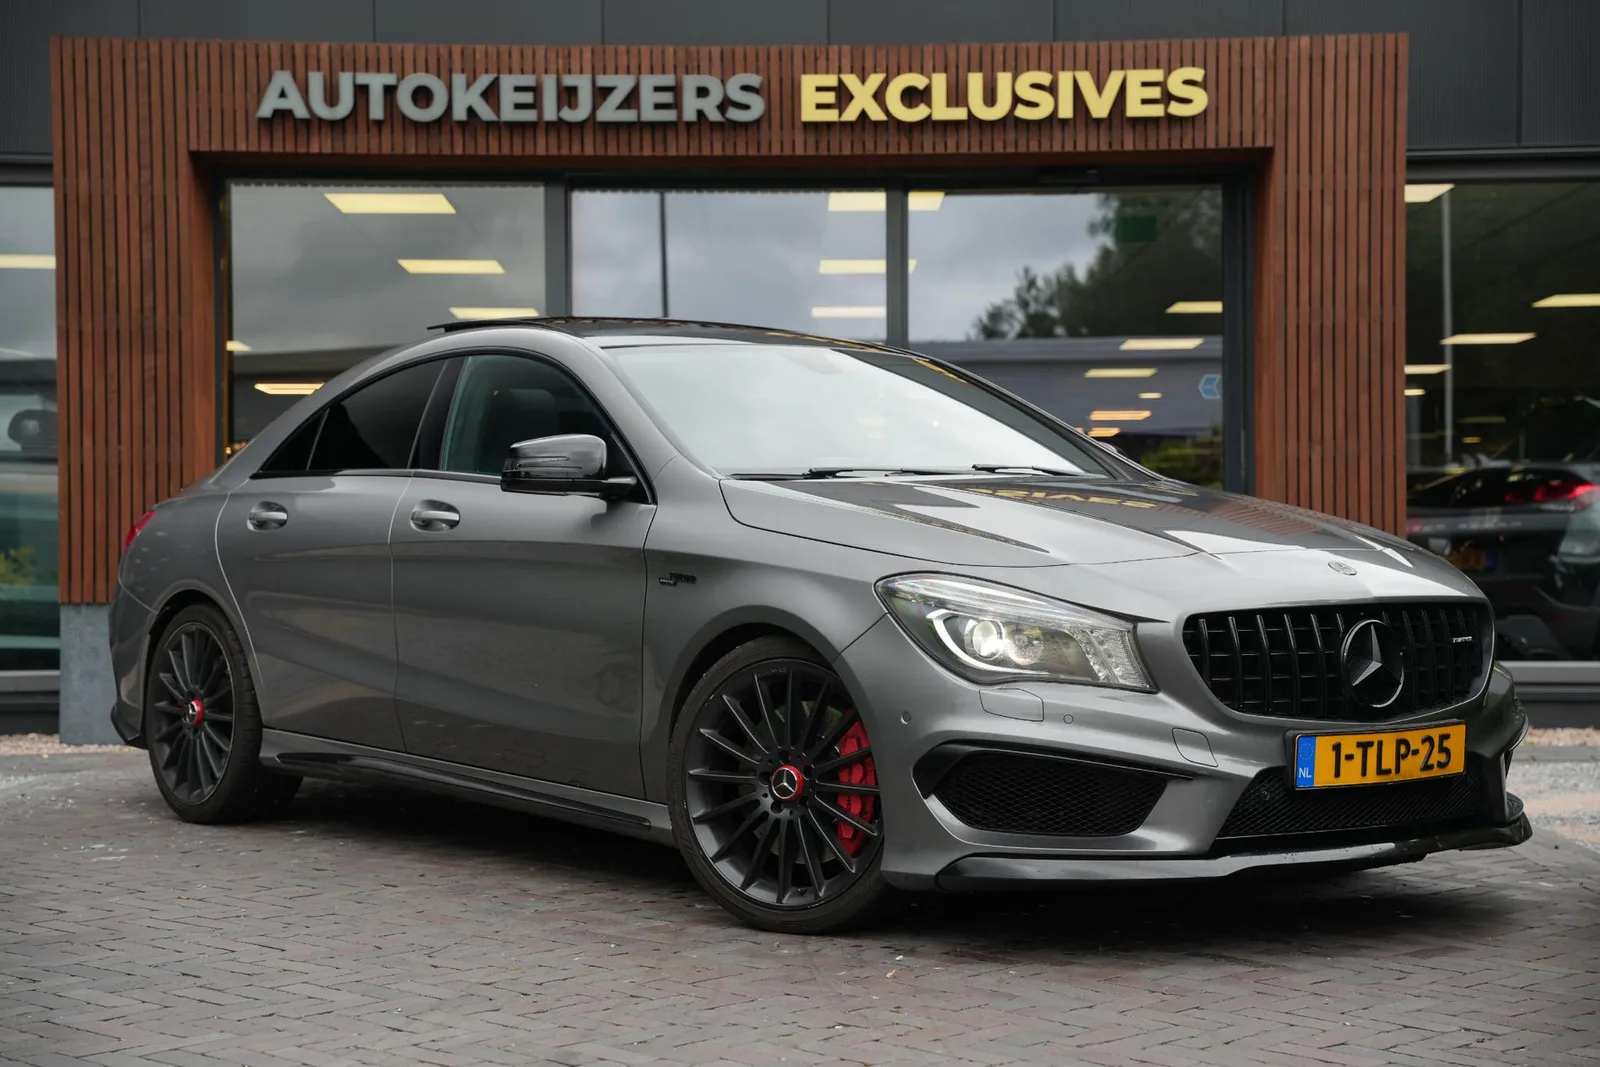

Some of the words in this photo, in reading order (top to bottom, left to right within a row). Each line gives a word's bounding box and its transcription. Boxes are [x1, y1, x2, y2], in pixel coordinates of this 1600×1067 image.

[256, 70, 766, 123] AUTOKEIJZERS
[800, 66, 1209, 123] EXCLUSIVES
[1298, 767, 1312, 779] NL
[1331, 733, 1452, 779] 1-TLP-25
